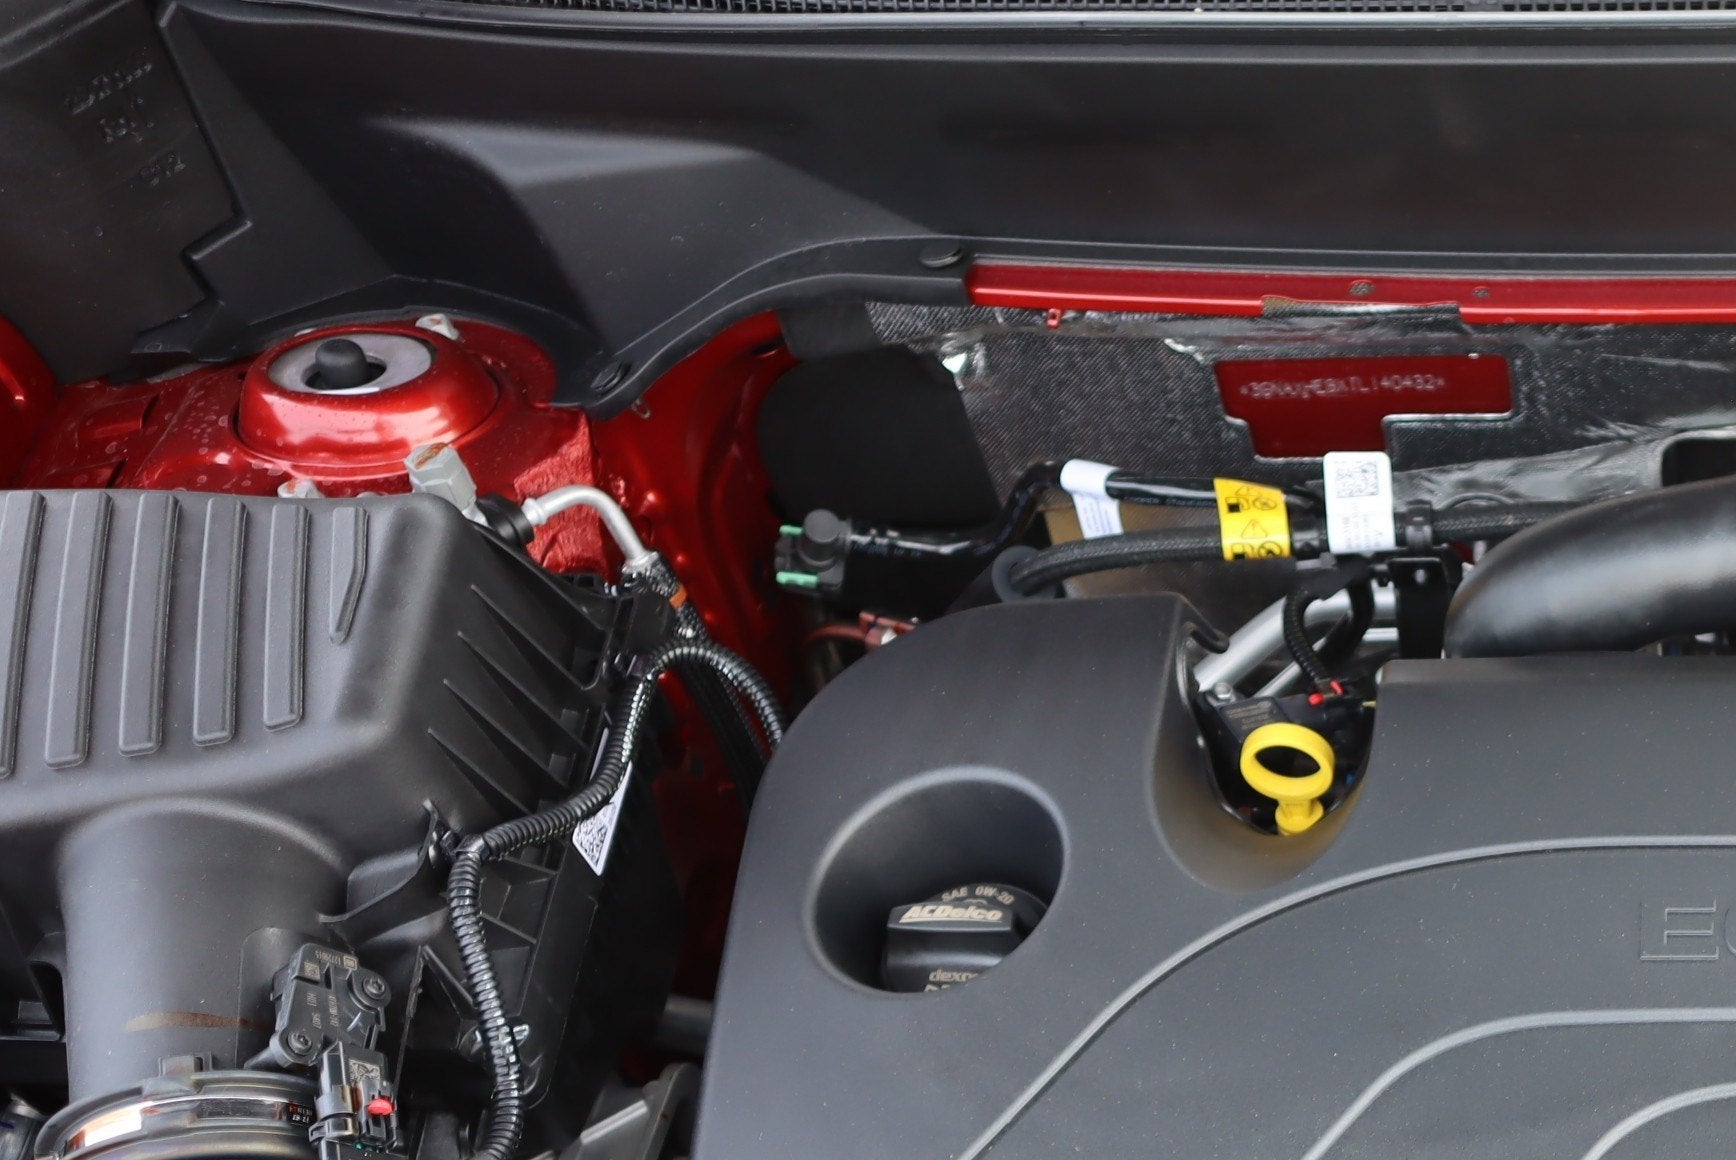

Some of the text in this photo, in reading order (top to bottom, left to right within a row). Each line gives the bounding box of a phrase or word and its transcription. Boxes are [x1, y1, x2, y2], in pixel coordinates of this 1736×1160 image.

[942, 885, 1015, 905] SAE 0W-20
[899, 904, 1004, 923] ACDelco
